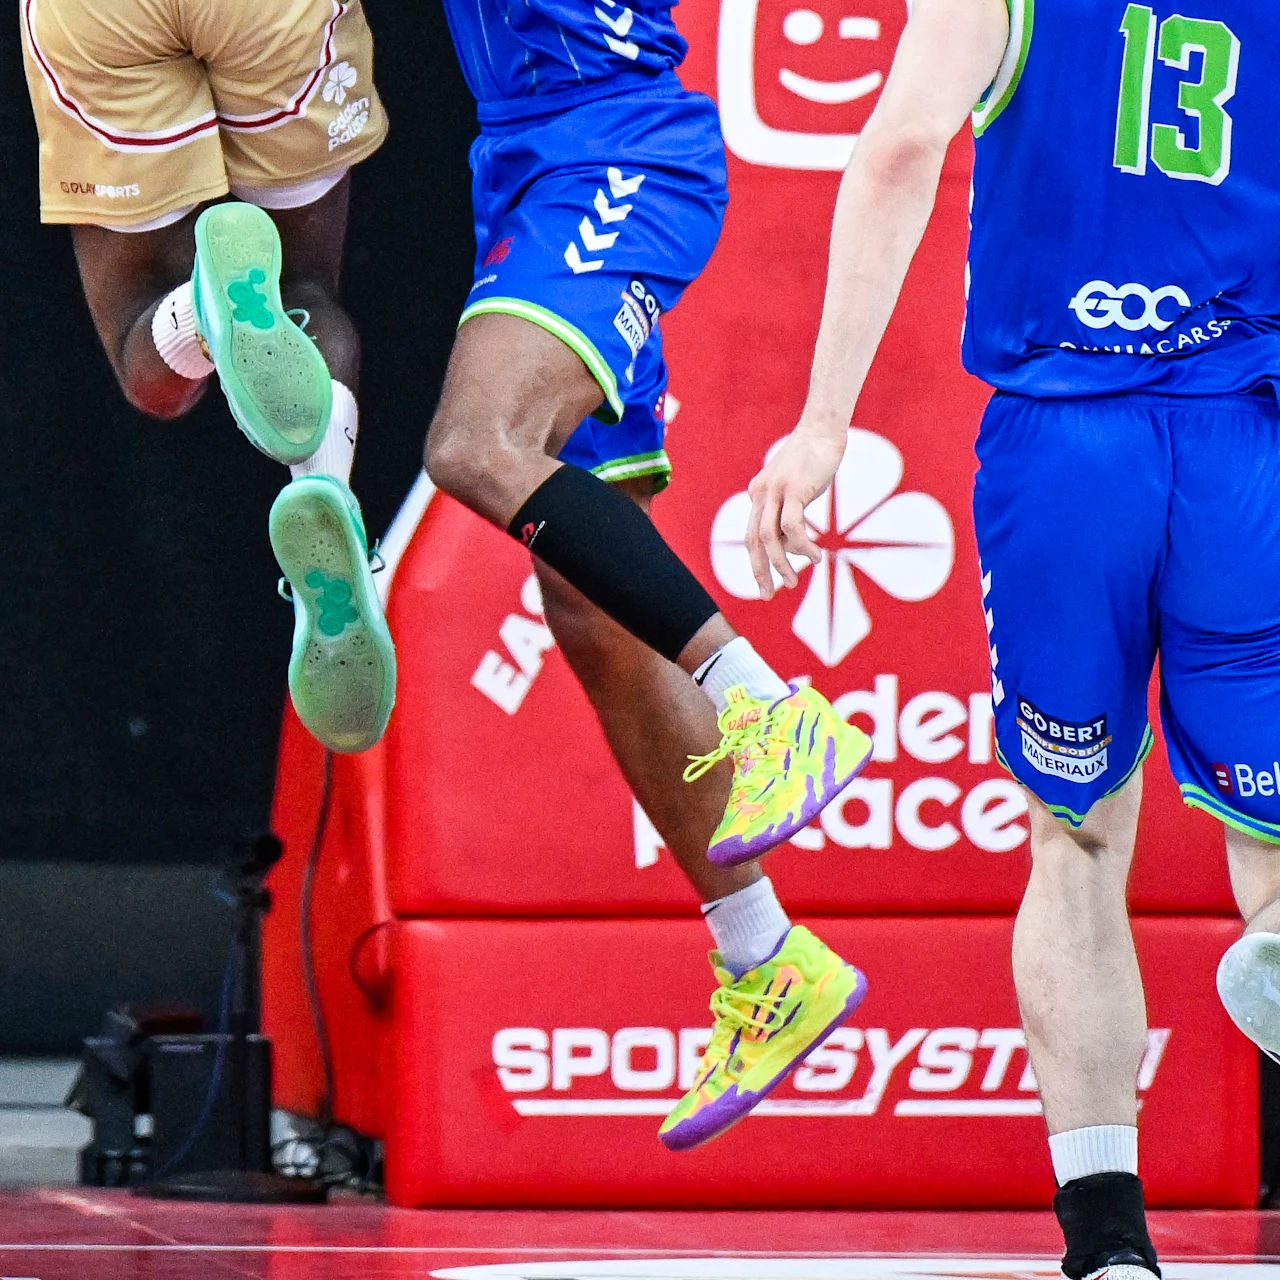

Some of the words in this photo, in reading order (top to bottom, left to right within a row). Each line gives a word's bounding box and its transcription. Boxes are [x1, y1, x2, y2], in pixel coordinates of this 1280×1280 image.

[1113, 2, 1241, 186] 13
[1020, 702, 1105, 742] GOBERT
[1023, 737, 1105, 777] MATERIAUX
